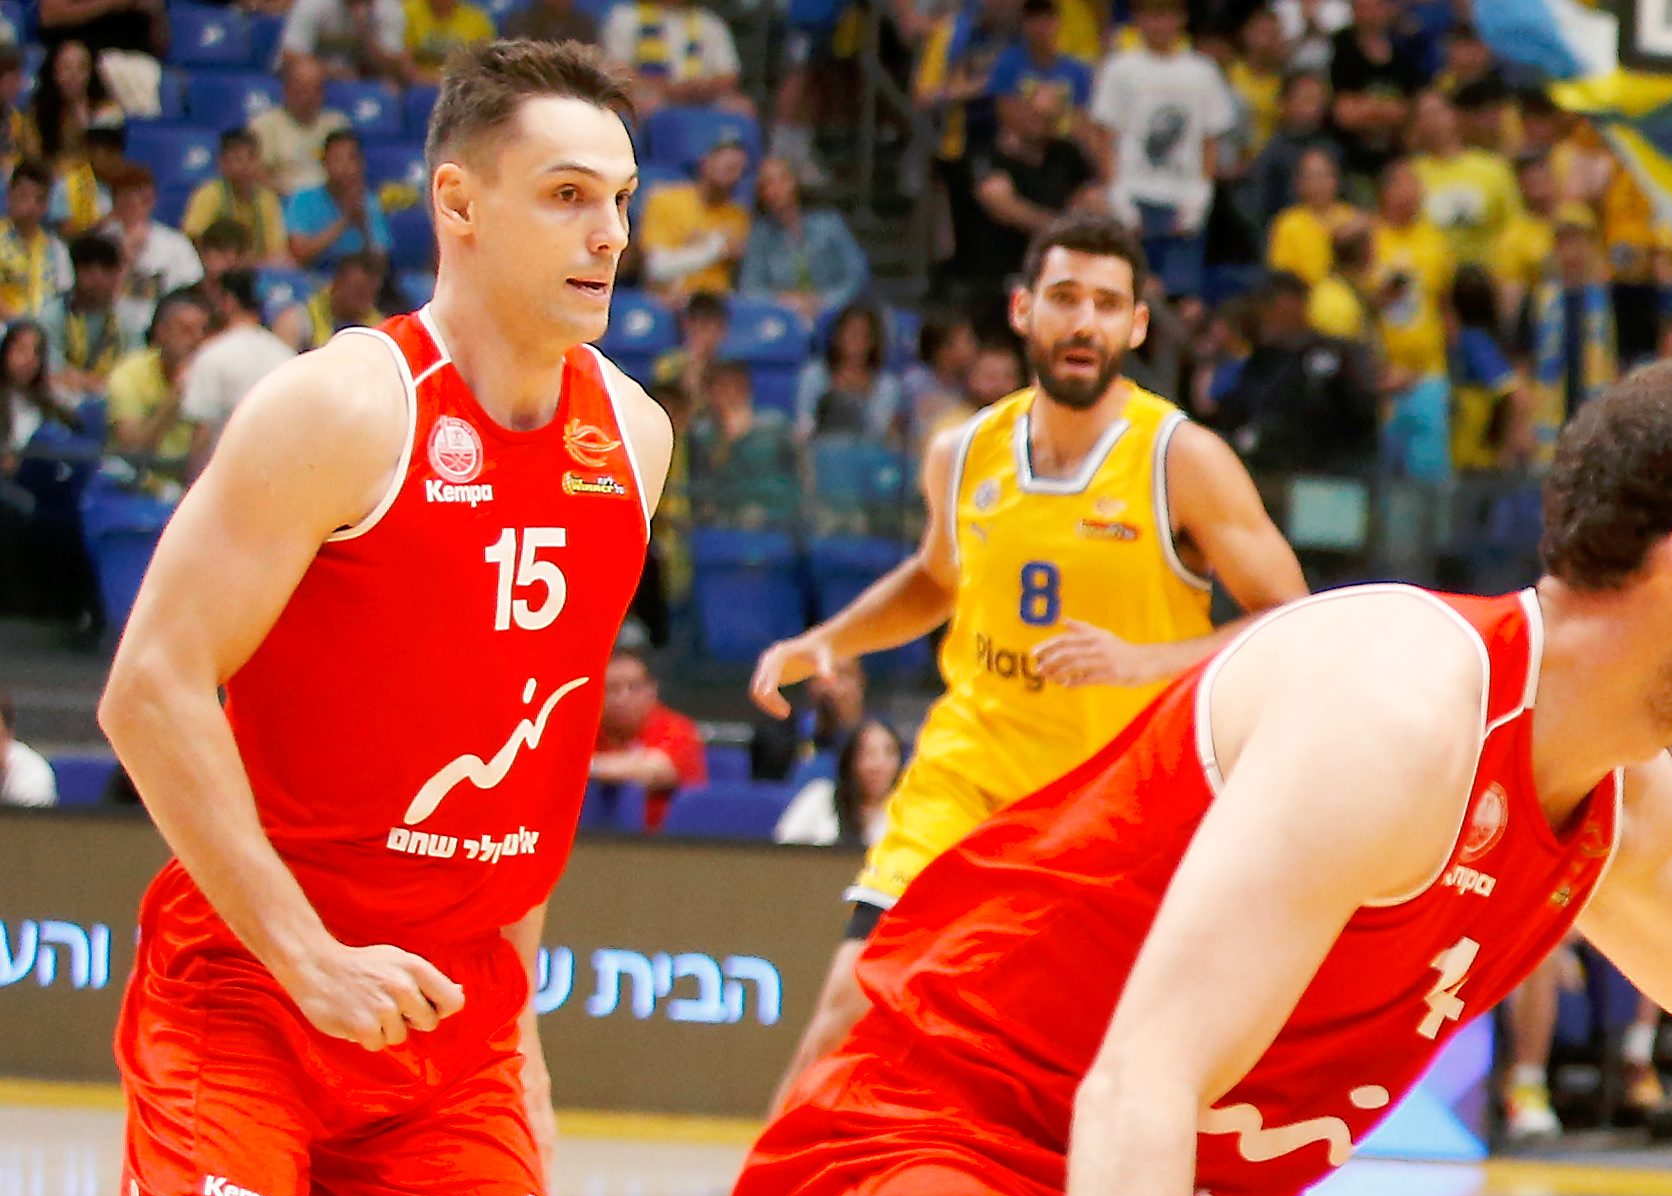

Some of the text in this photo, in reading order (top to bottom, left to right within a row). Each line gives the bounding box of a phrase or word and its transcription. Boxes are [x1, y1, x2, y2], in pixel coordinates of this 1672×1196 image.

[425, 479, 494, 508] Kempa
[484, 526, 568, 632] 15
[1019, 560, 1061, 626] 8
[975, 632, 1045, 693] Play
[386, 826, 459, 859] שחם
[585, 947, 783, 1025] הבית
